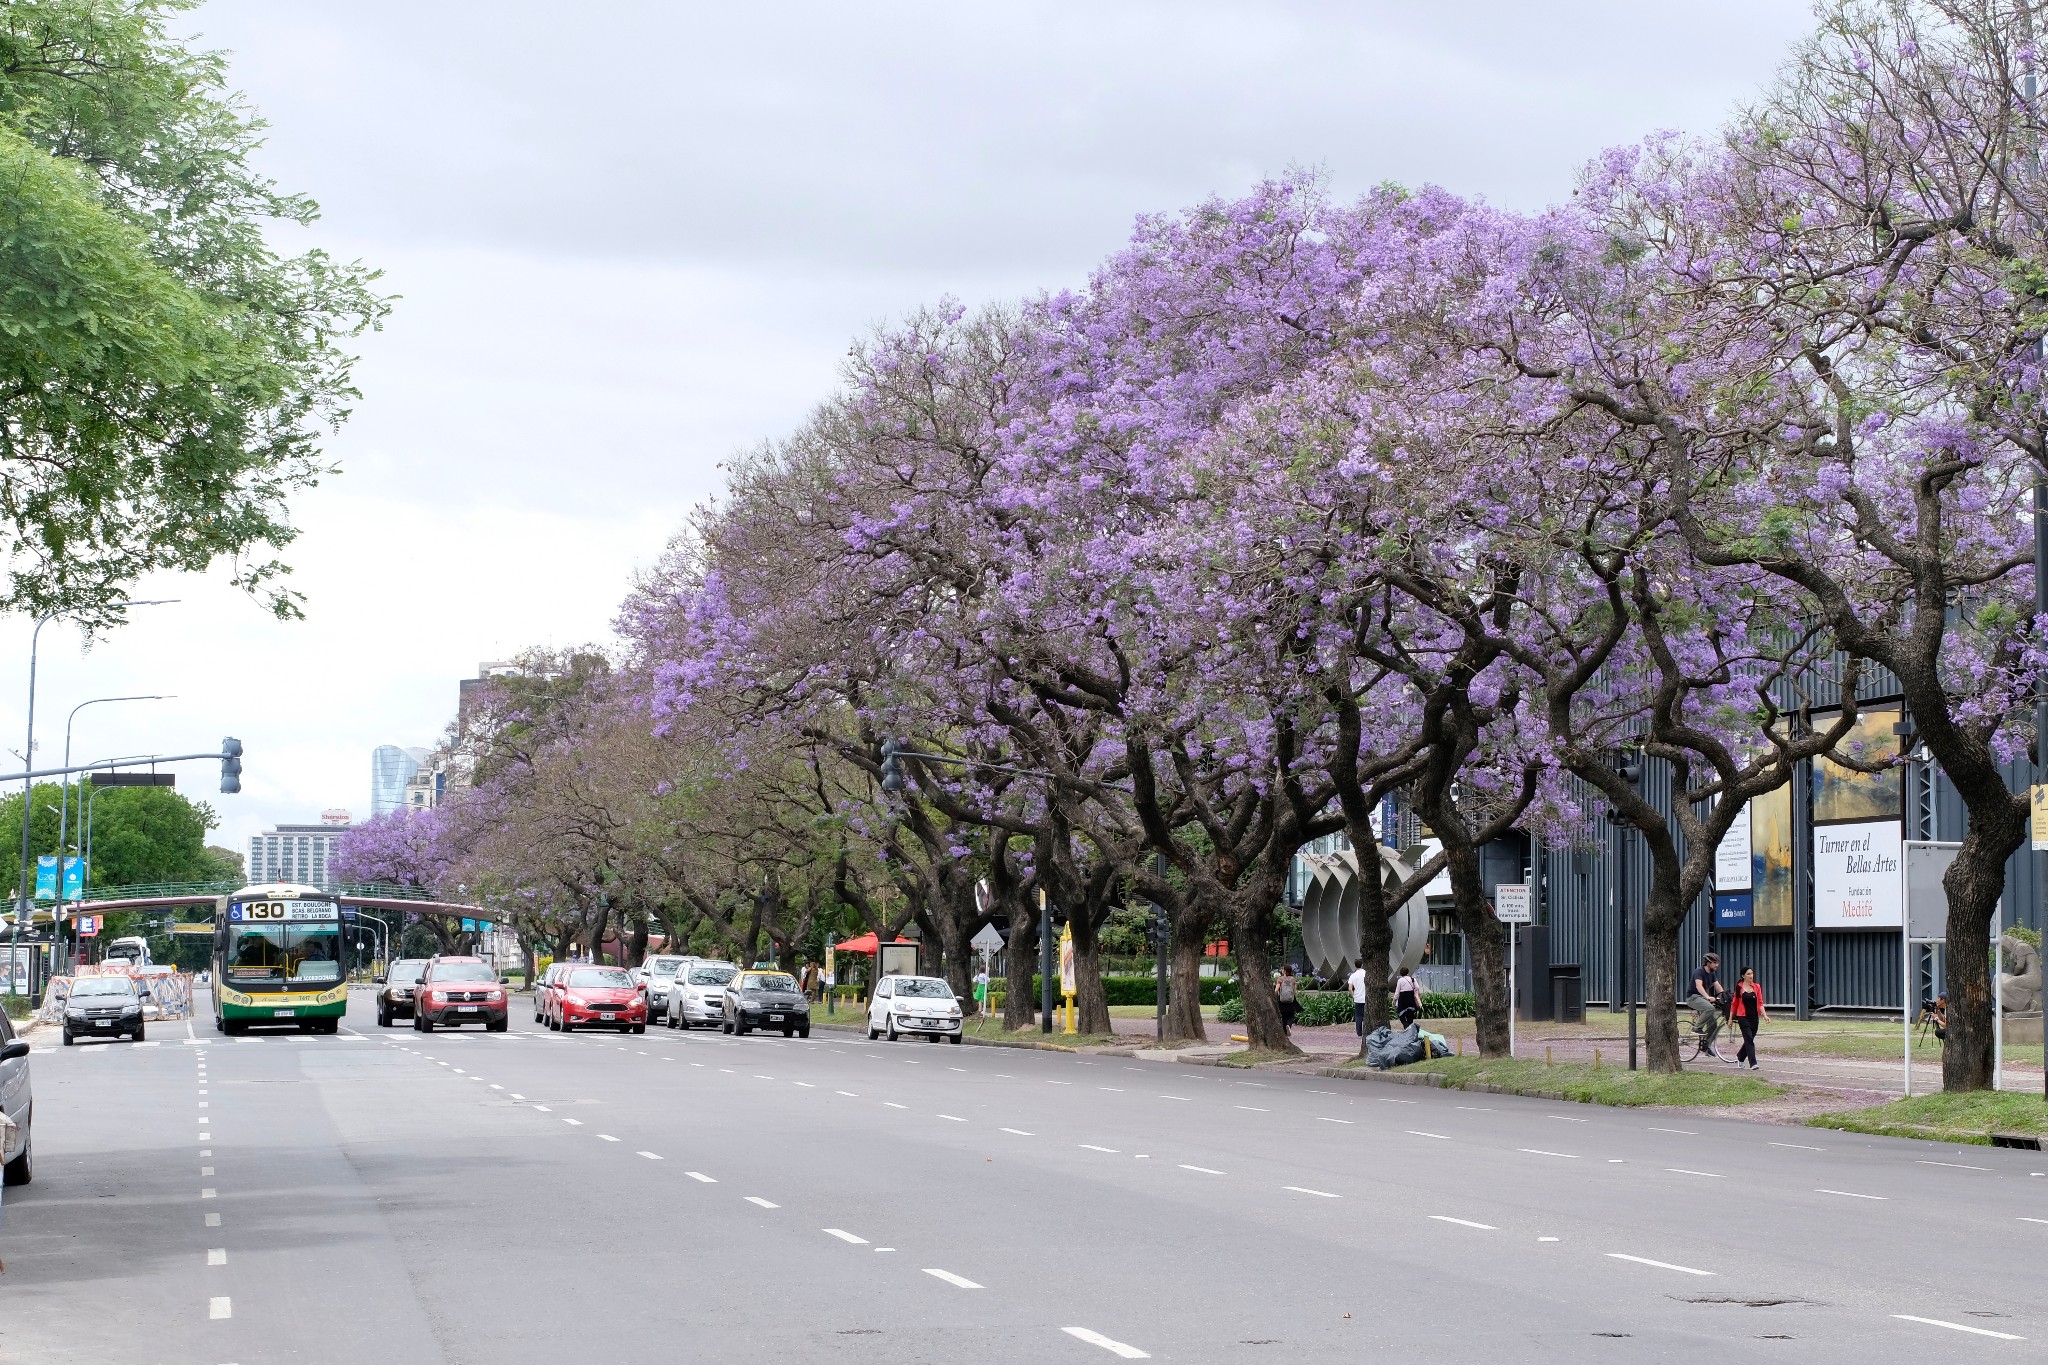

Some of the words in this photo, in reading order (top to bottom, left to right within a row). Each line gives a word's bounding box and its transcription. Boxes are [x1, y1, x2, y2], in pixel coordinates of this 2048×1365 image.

[1819, 835, 1850, 854] Turner
[1850, 839, 1861, 852] en
[1862, 833, 1871, 851] el
[1846, 855, 1872, 874] Bellas
[1872, 854, 1897, 873] Artes
[38, 873, 55, 881] G20
[1848, 886, 1872, 896] Fundación
[245, 902, 285, 919] 130
[1842, 900, 1873, 918] Medifé
